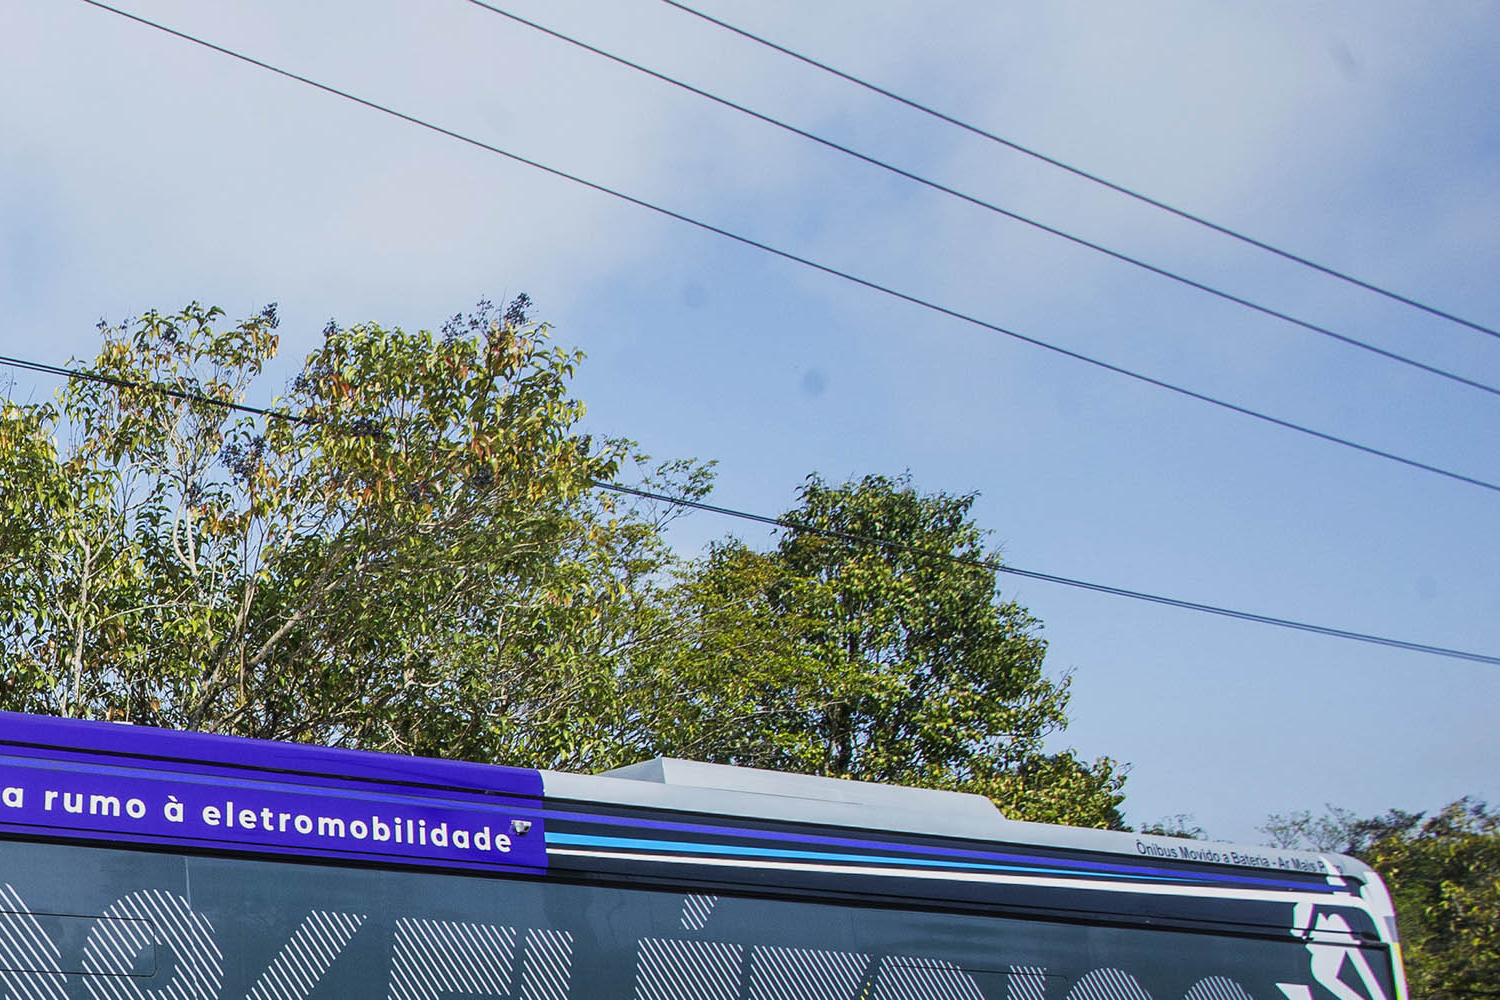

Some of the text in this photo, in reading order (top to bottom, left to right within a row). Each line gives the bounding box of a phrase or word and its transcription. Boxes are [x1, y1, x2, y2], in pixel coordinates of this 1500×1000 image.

[45, 789, 146, 819] rumo
[164, 795, 185, 824] à
[202, 802, 512, 853] eletromobilidade
[1135, 839, 1177, 858] Ônibus
[1179, 846, 1220, 863] Movido
[1231, 852, 1269, 867] Bateria
